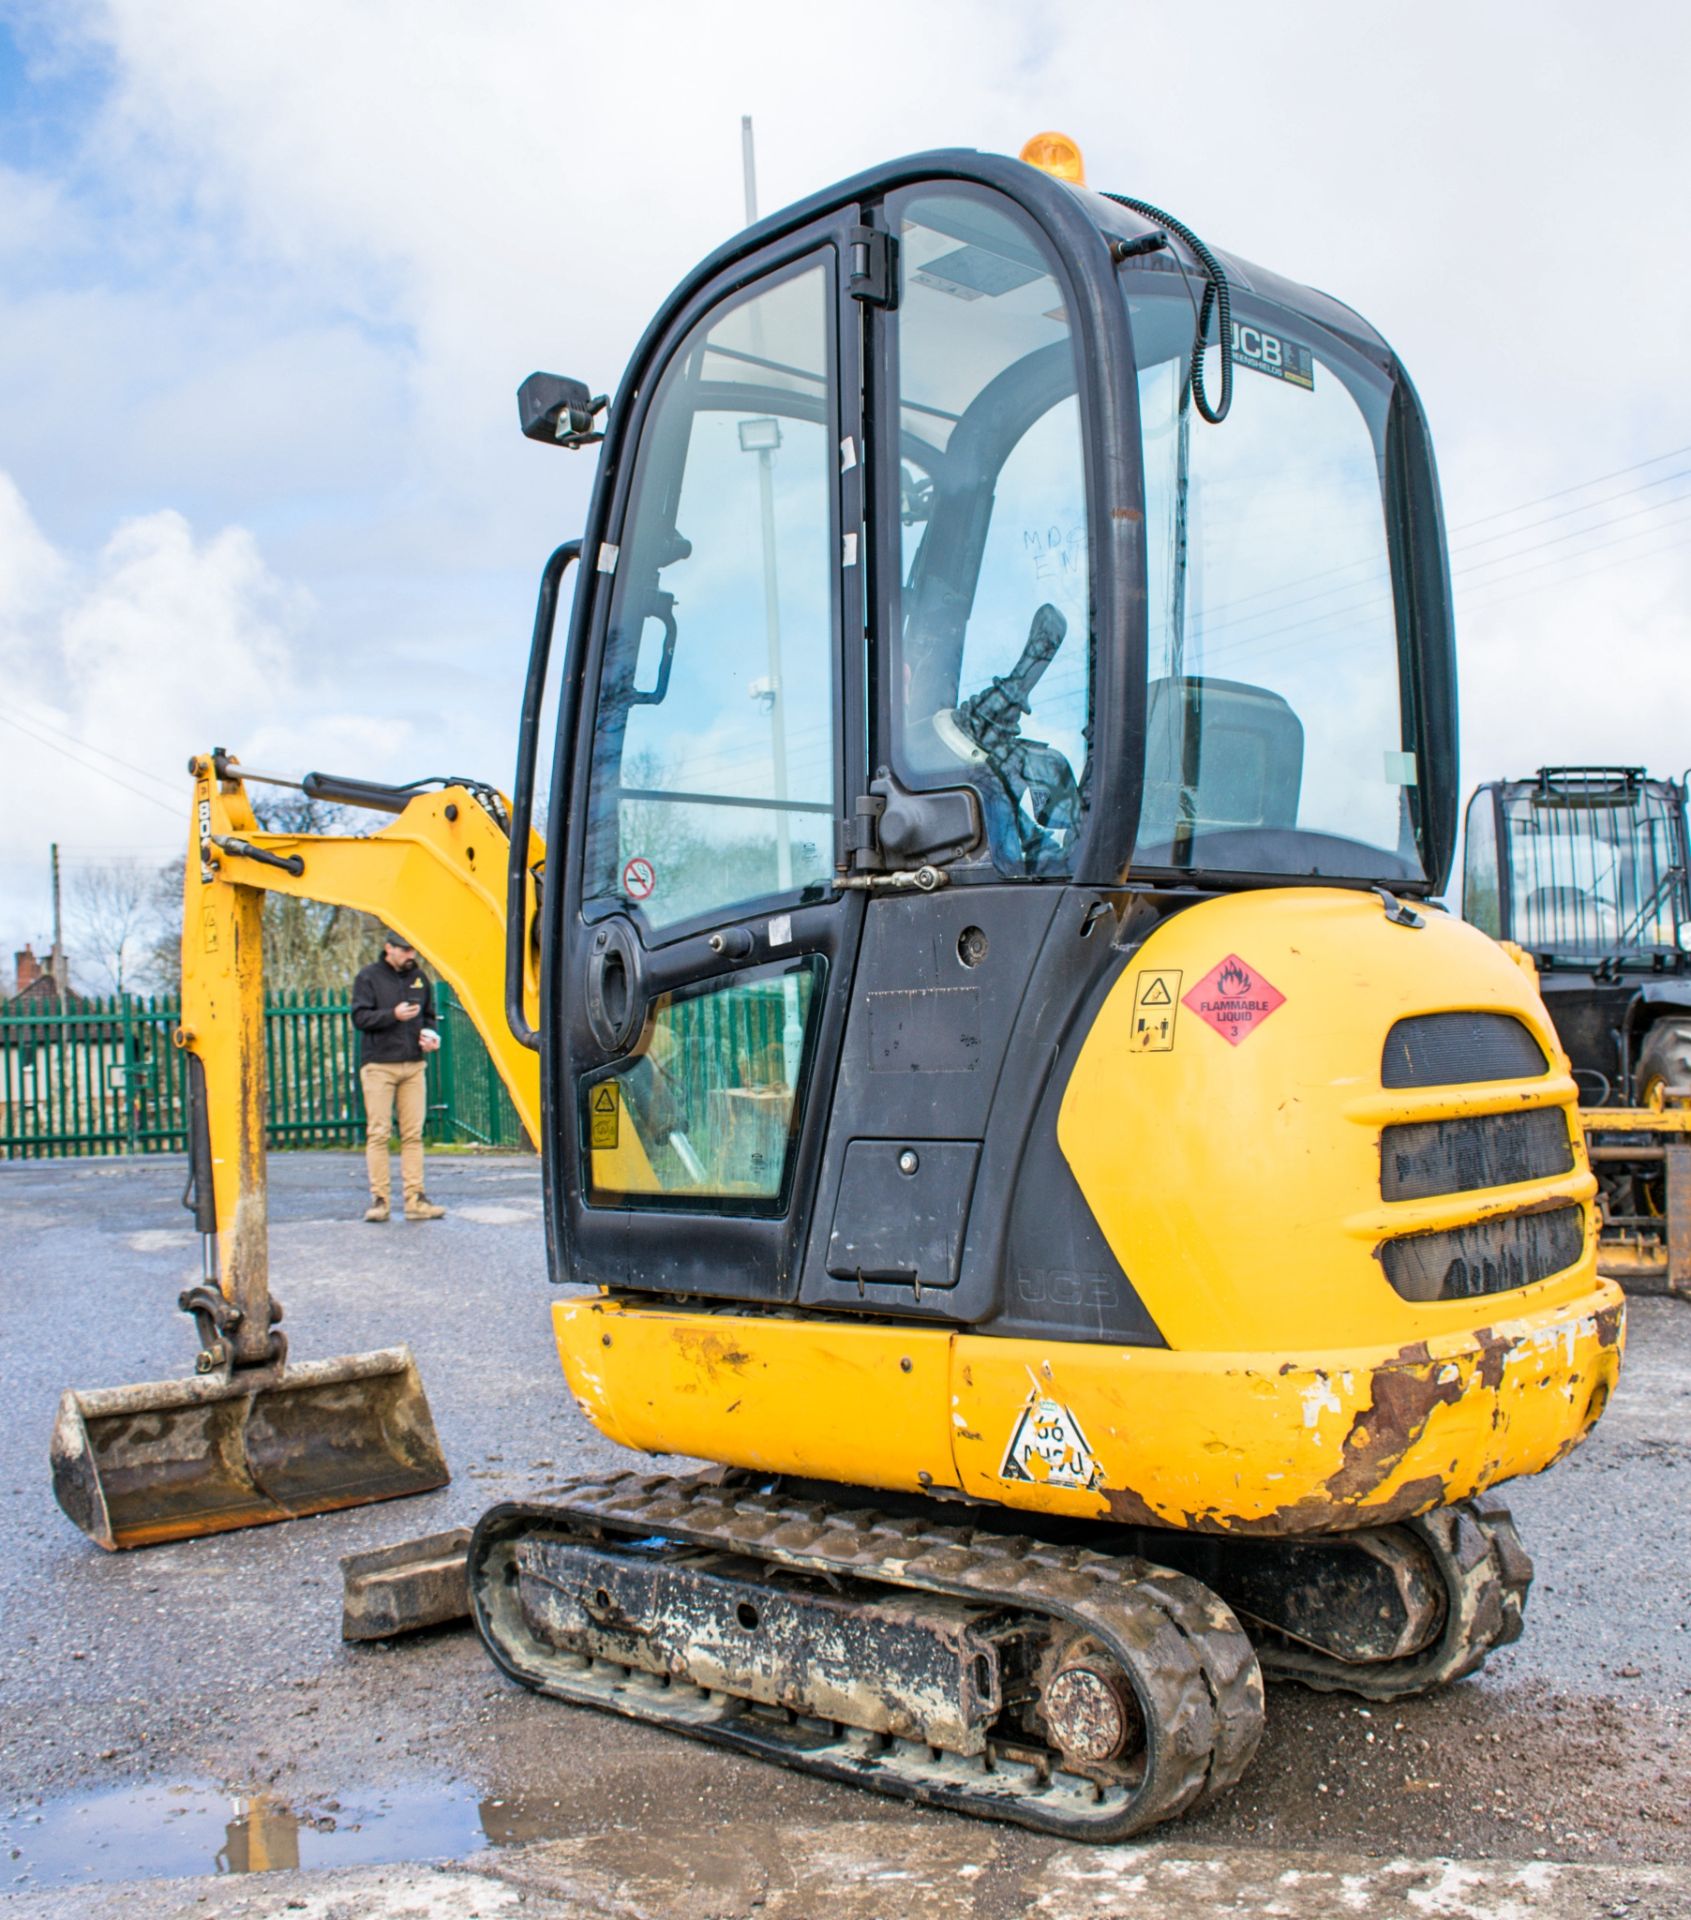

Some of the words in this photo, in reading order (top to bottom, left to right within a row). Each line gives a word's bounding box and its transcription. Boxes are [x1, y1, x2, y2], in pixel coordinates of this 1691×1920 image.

[1231, 322, 1282, 366] JCB
[1201, 1001, 1269, 1011] FLAMMABLE
[1217, 1011, 1252, 1022] LIQUID
[1230, 1025, 1239, 1037] 3
[1017, 1267, 1119, 1308] JCB
